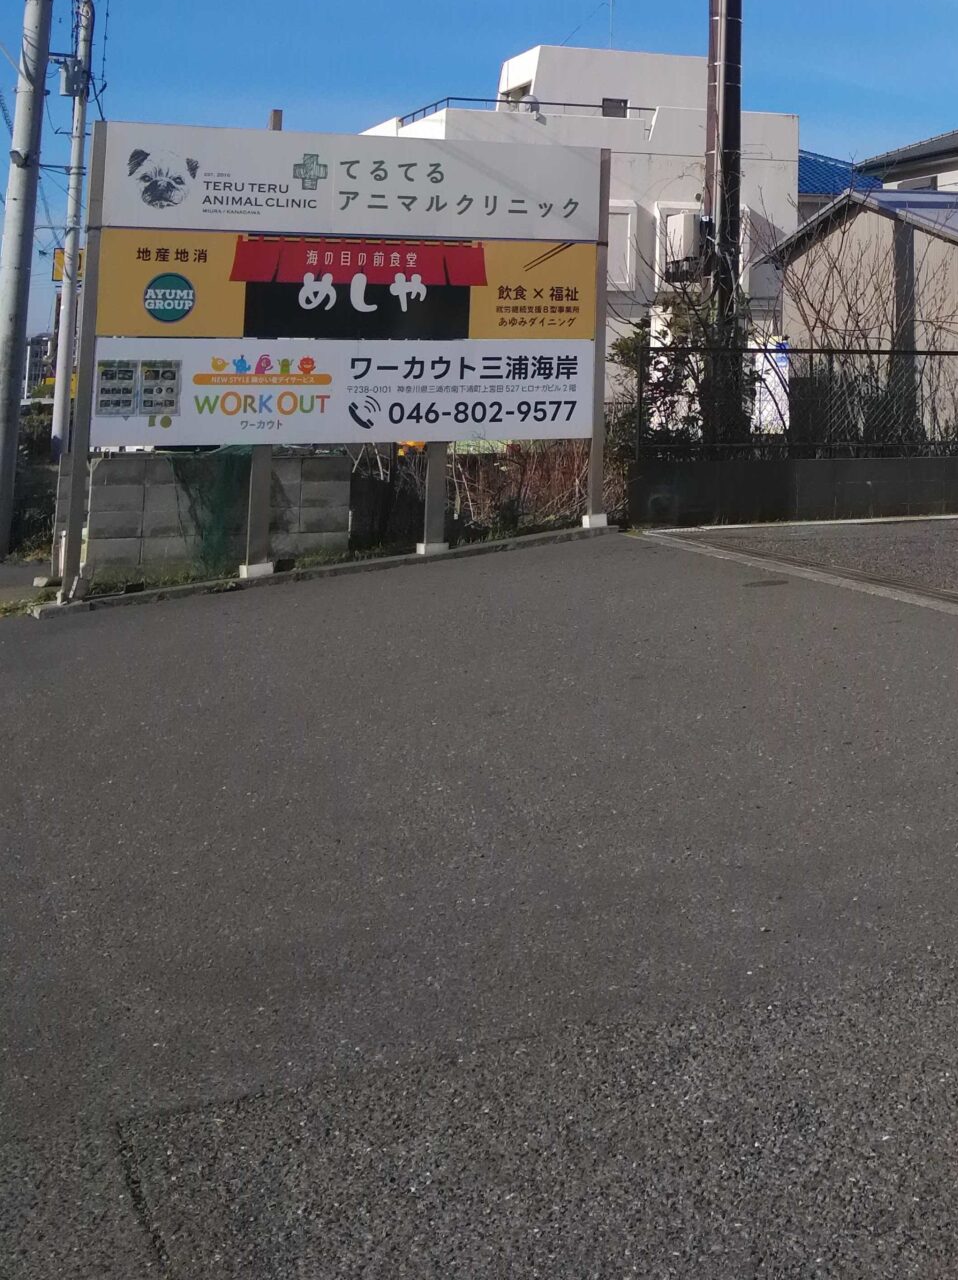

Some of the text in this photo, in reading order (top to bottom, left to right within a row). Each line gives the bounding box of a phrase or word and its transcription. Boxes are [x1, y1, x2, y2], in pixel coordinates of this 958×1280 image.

[339, 160, 445, 184] てるてる
[203, 181, 289, 194] TERU TERU
[202, 195, 318, 209] ANIMAL CLINIC
[338, 190, 579, 219] アニマルクリニック
[136, 248, 208, 263] 地産地消
[306, 250, 418, 268] 海の目の前食堂
[145, 289, 194, 299] AYUMI
[298, 272, 427, 313] めしや
[497, 285, 527, 301] 飲食
[549, 286, 579, 302] 福祉
[145, 300, 193, 310] GROUP
[498, 317, 577, 328] あゆみダイニング
[350, 355, 578, 380] ワーカウト三浦海岸
[194, 391, 330, 416] WORK OUT
[388, 401, 577, 425] 046-802-9577
[240, 419, 283, 429] ワーカウト
